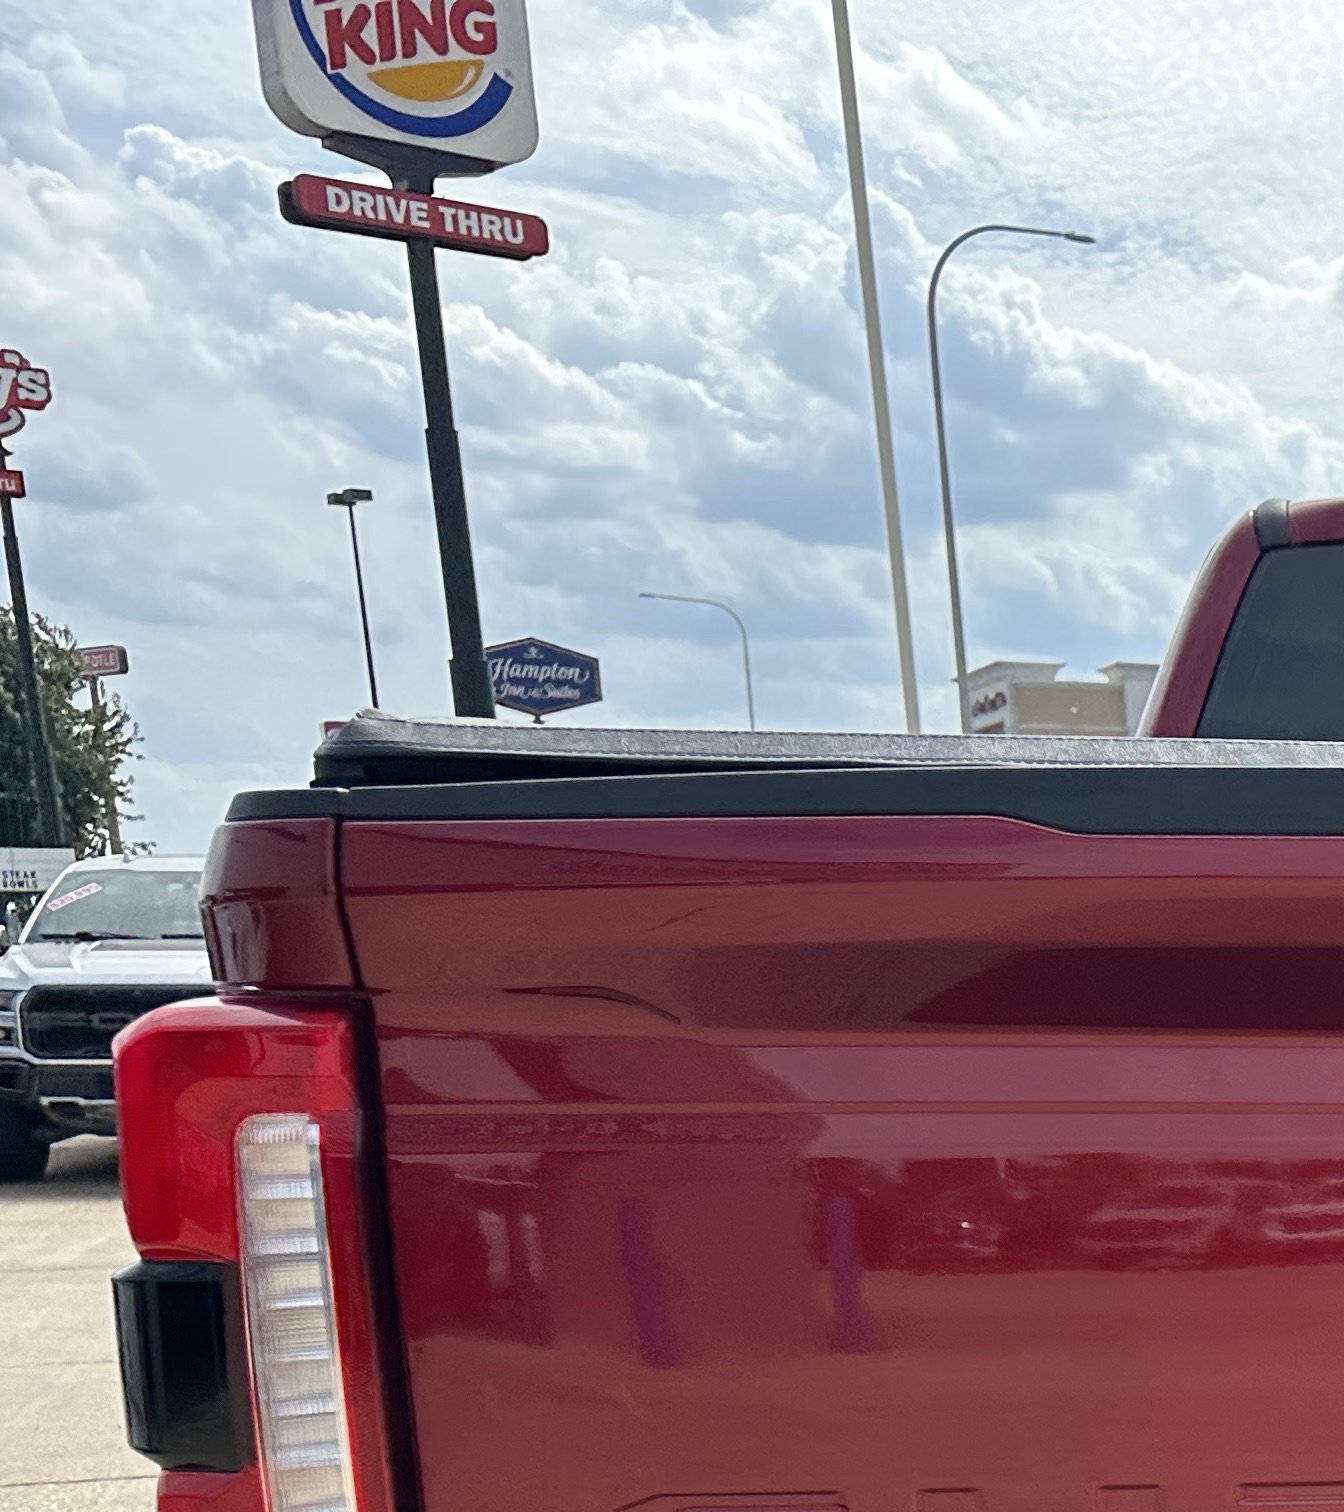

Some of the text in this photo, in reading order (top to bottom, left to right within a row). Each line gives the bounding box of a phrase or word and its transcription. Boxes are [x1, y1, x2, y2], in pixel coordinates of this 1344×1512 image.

[324, 0, 498, 71] KING
[324, 184, 525, 245] DRIVE THRU
[488, 658, 590, 684] Hampton
